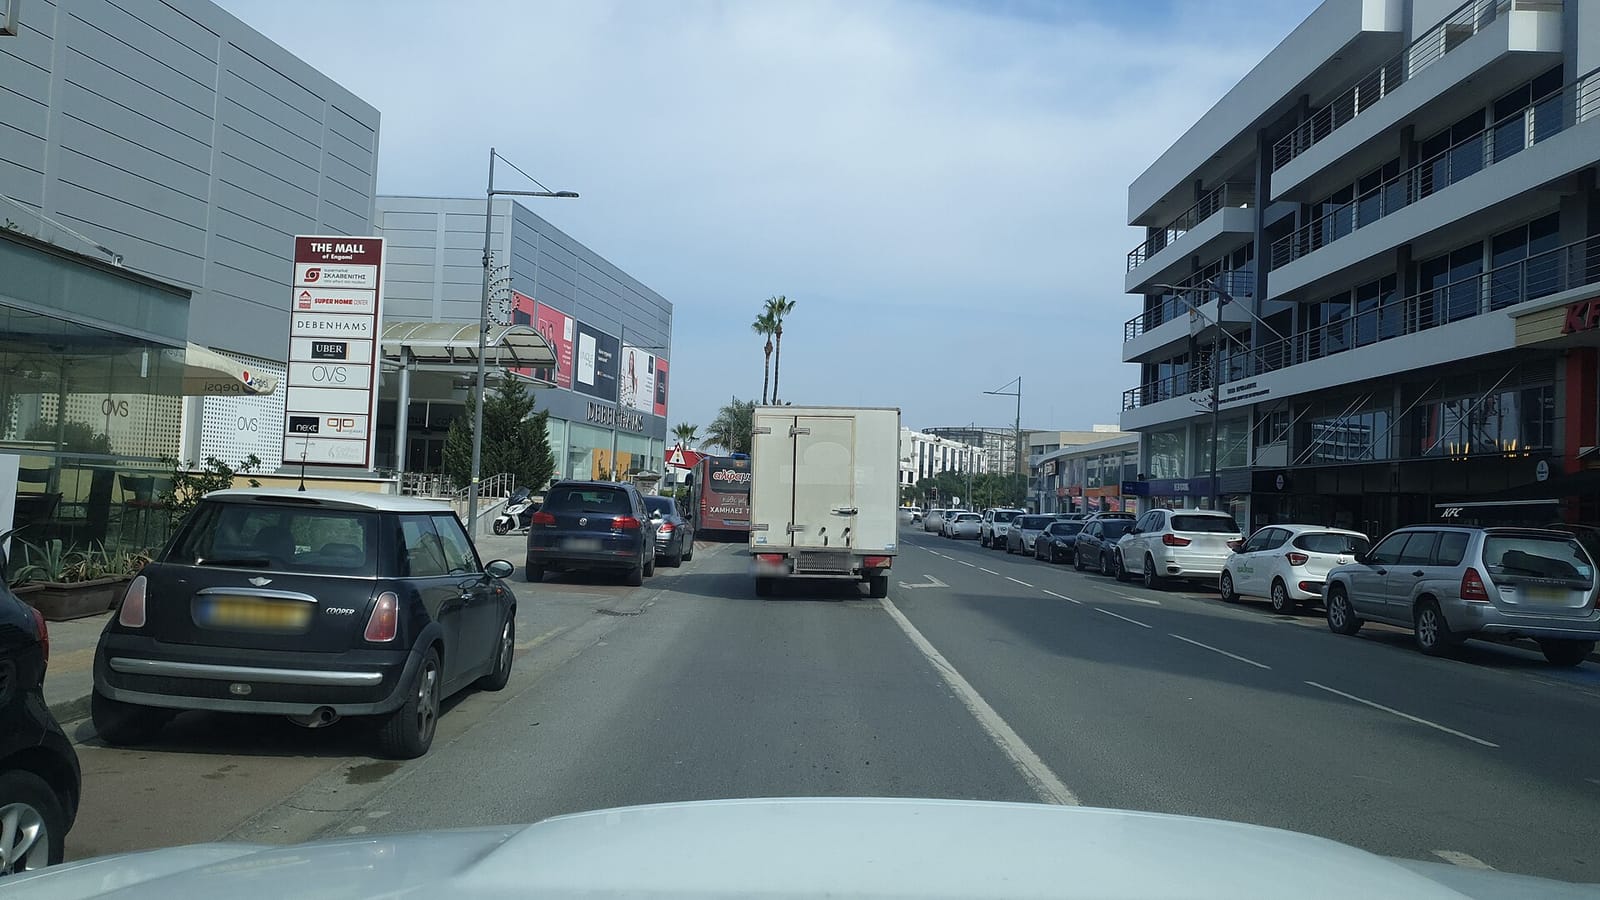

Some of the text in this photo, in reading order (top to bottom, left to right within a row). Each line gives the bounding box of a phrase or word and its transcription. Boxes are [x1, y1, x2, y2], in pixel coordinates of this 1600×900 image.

[311, 243, 365, 254] THE MALL
[297, 321, 367, 331] DEBENHAMS
[316, 344, 343, 353] UBER
[312, 365, 347, 383] OVS
[102, 398, 129, 418] OVS
[237, 416, 258, 432] OVS
[296, 424, 317, 432] next
[710, 506, 743, 514] ΧΑΜΗΛΕΣ
[1440, 507, 1464, 518] KFC
[326, 607, 355, 615] COOPER
